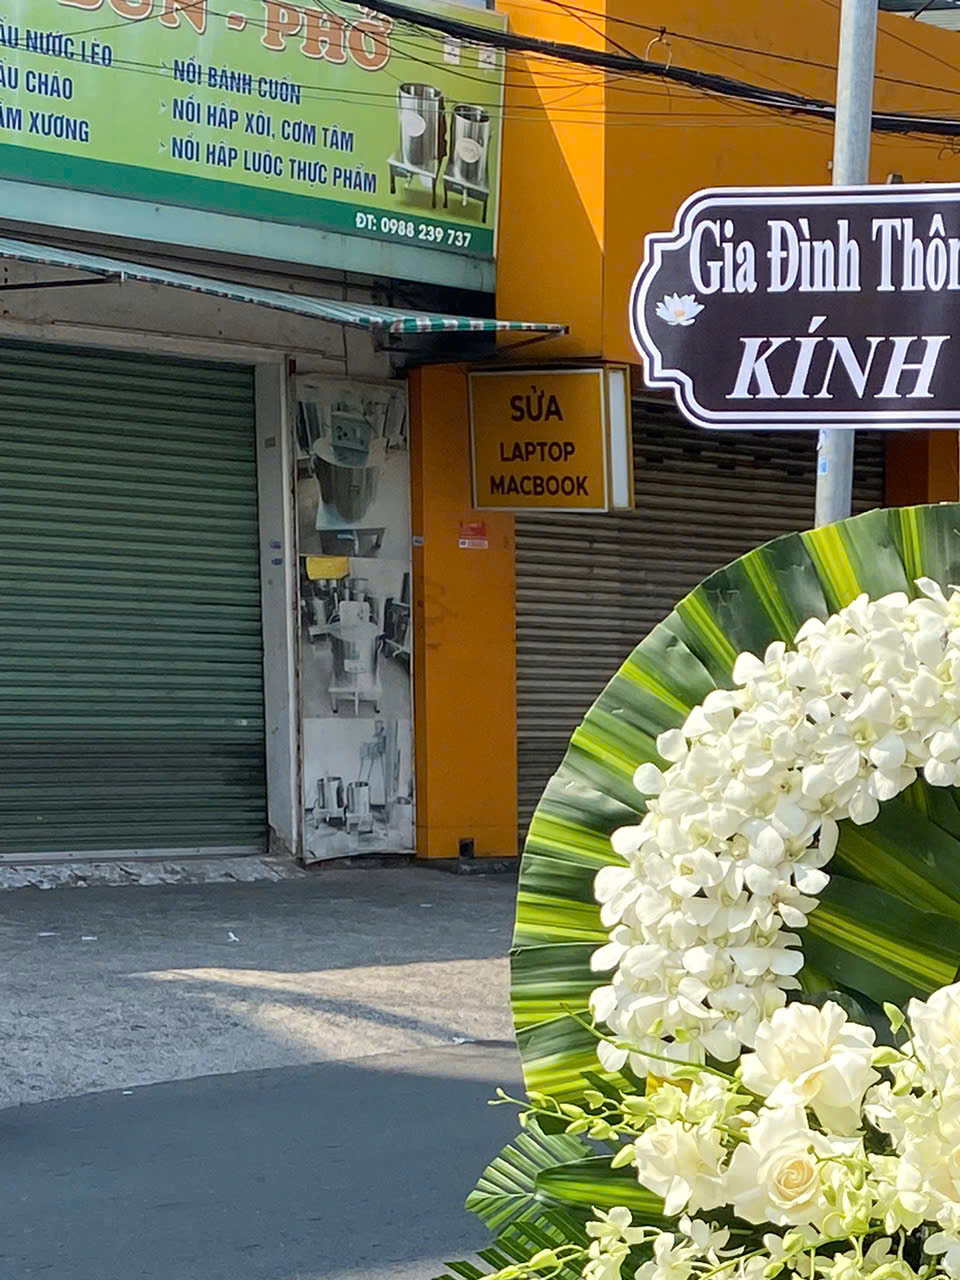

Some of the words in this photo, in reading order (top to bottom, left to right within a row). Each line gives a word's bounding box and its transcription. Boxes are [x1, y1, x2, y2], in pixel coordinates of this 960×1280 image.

[29, 111, 90, 142] XƯƠNG
[281, 119, 316, 146] CƠM
[355, 211, 377, 231] ĐT:
[381, 217, 415, 238] 0988
[418, 223, 444, 243] 239
[447, 229, 472, 248] 737
[689, 219, 757, 293] Gia
[766, 217, 860, 293] Đình
[725, 315, 951, 399] KÍNH
[510, 386, 563, 422] SỬA
[500, 441, 576, 463] LAPTOP
[489, 474, 590, 497] MACBOOK
